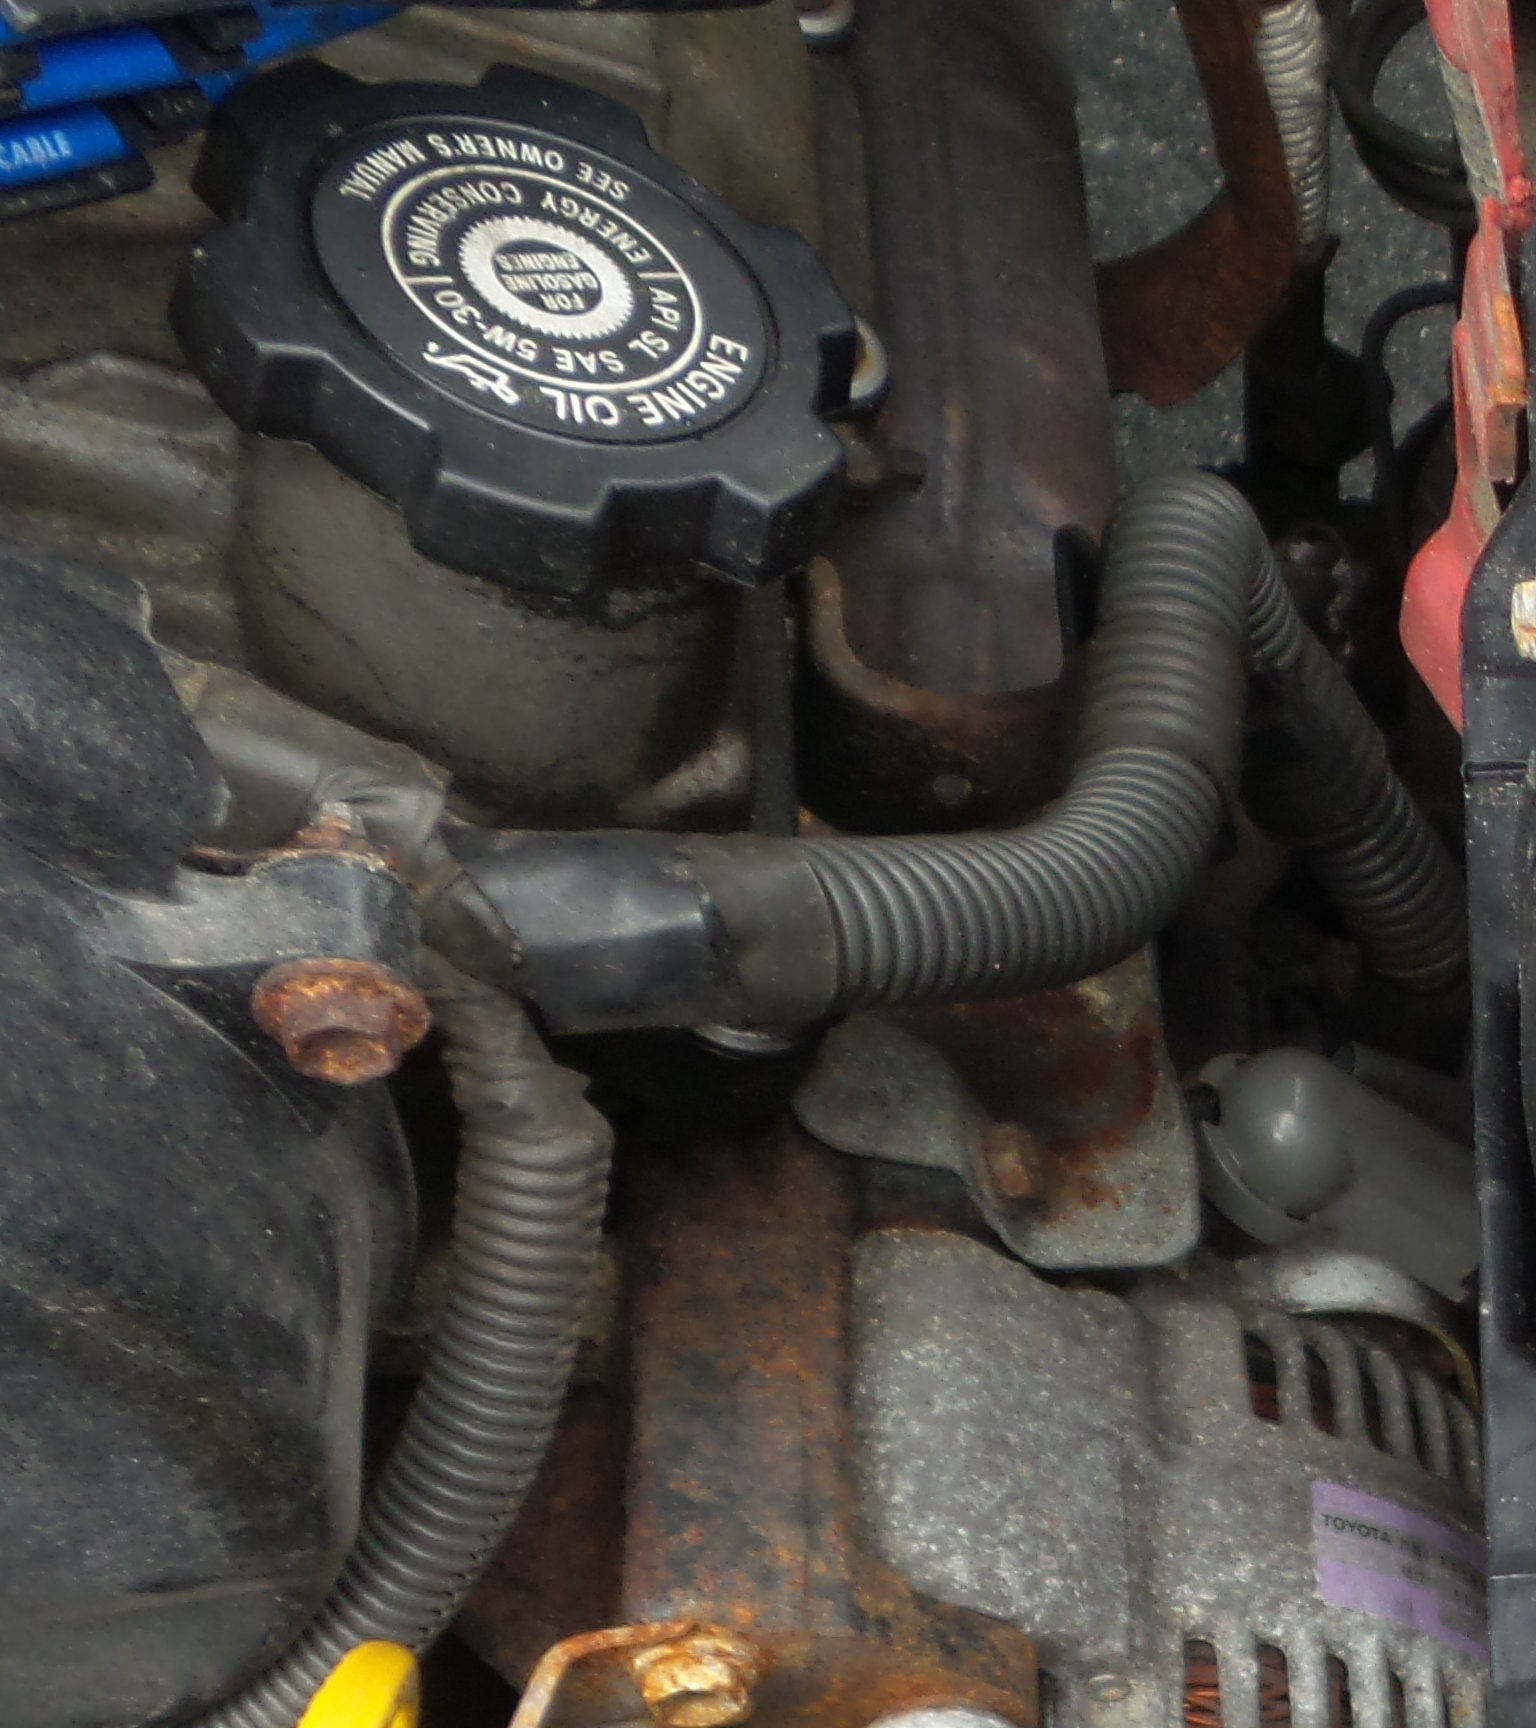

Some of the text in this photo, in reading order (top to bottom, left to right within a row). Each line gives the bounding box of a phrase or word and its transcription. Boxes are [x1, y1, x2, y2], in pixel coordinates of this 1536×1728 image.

[339, 132, 631, 200] SEE OWNER'S MANUAL
[406, 182, 653, 266] ENERGY CONSERVING
[495, 252, 580, 272] ENGINES
[500, 272, 598, 291] GASOLINE
[539, 292, 584, 311] FOR
[435, 286, 682, 375] API SL SAE 5W-30
[538, 333, 748, 426] ENGINE OIL
[1320, 1512, 1392, 1546] TOYOTA
